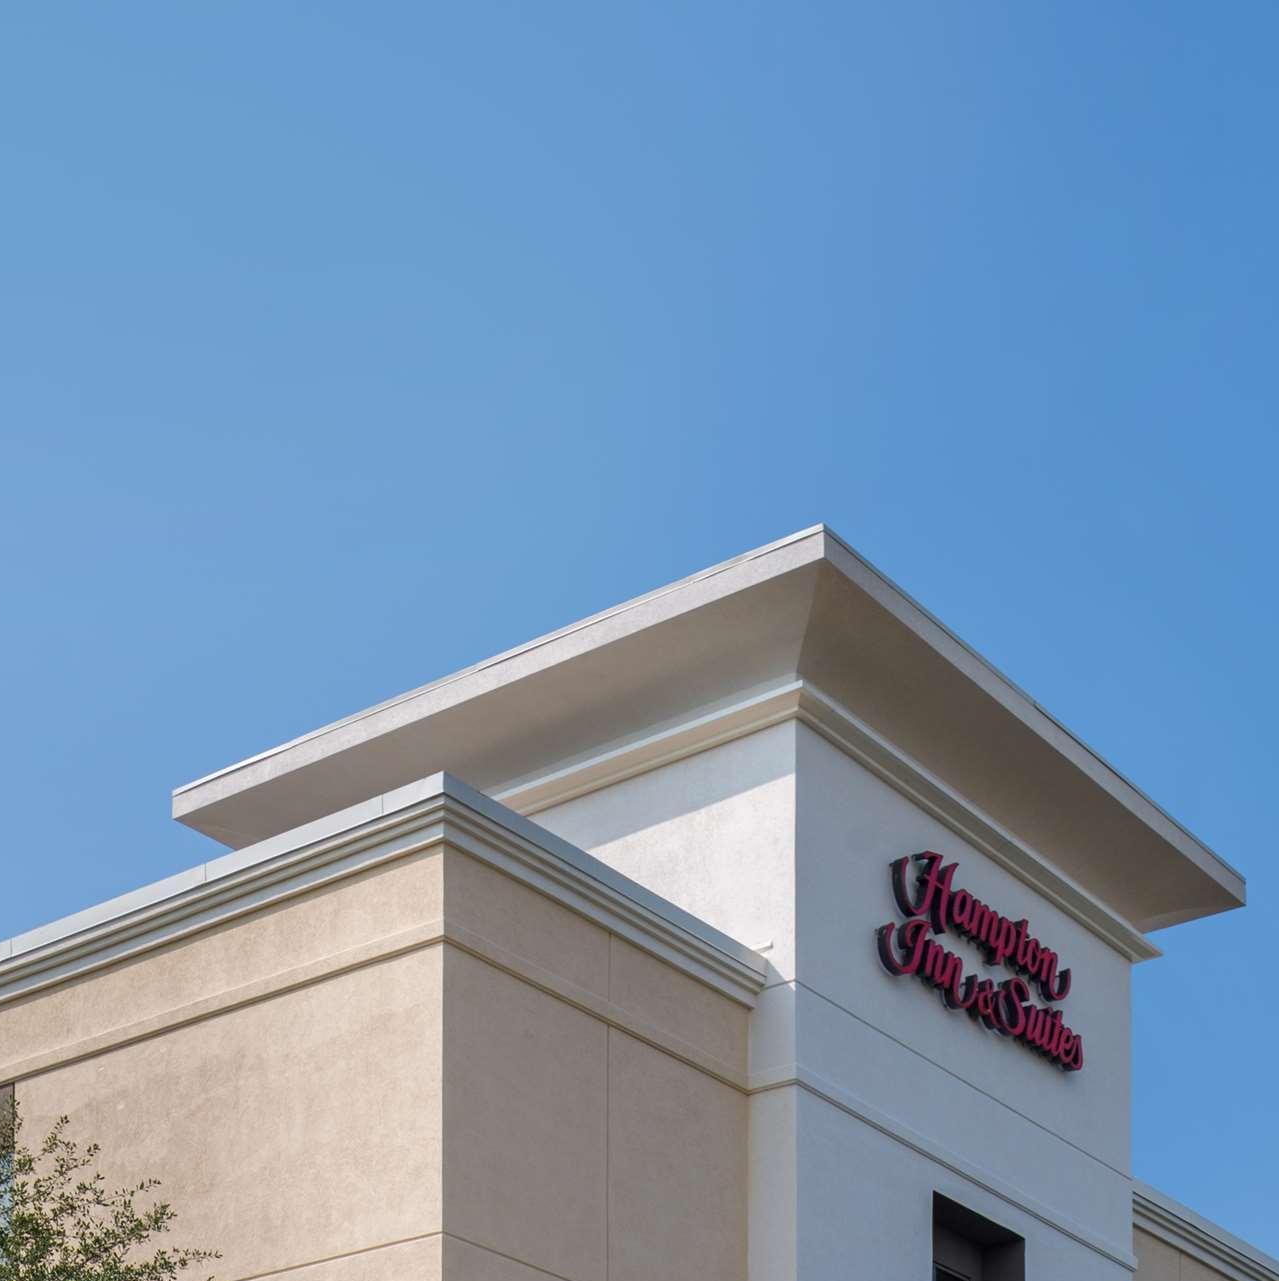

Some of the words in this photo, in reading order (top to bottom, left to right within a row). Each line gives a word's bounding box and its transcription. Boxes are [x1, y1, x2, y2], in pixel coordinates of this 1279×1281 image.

[875, 918, 978, 1010] Inn
[994, 977, 1083, 1071] Suites
[889, 850, 1071, 1001] Hampton
